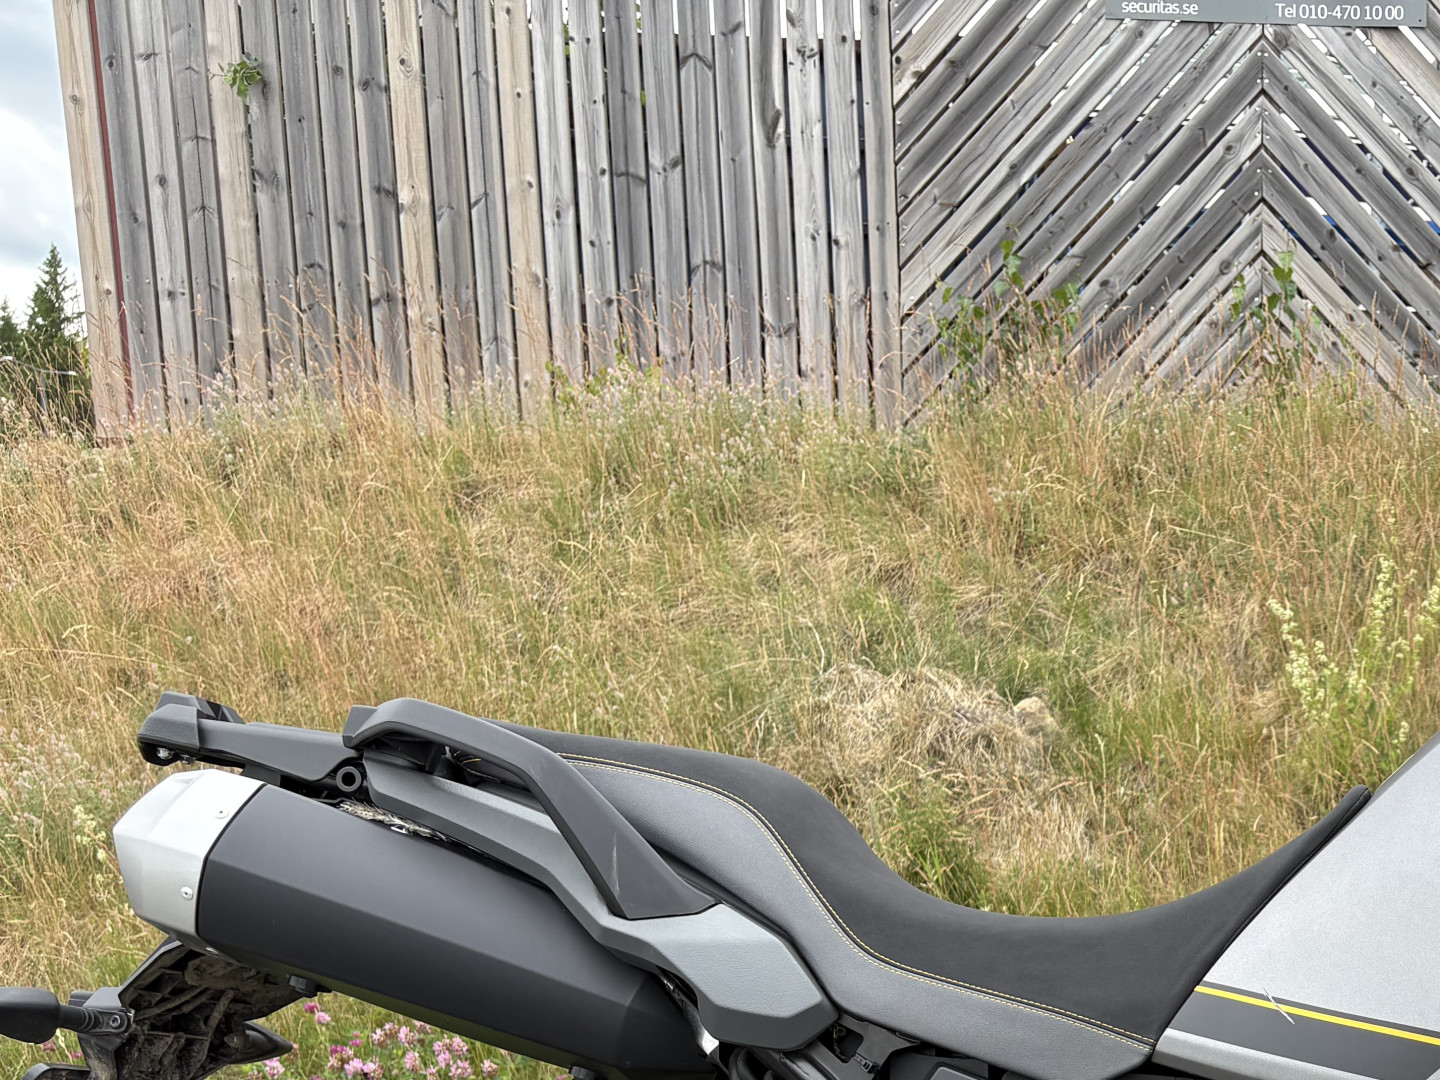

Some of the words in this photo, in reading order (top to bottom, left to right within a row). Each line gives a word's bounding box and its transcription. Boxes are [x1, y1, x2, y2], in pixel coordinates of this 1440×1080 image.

[1121, 0, 1199, 15] securitas.se
[1275, 3, 1296, 18] Tel
[1299, 5, 1360, 20] 010-470
